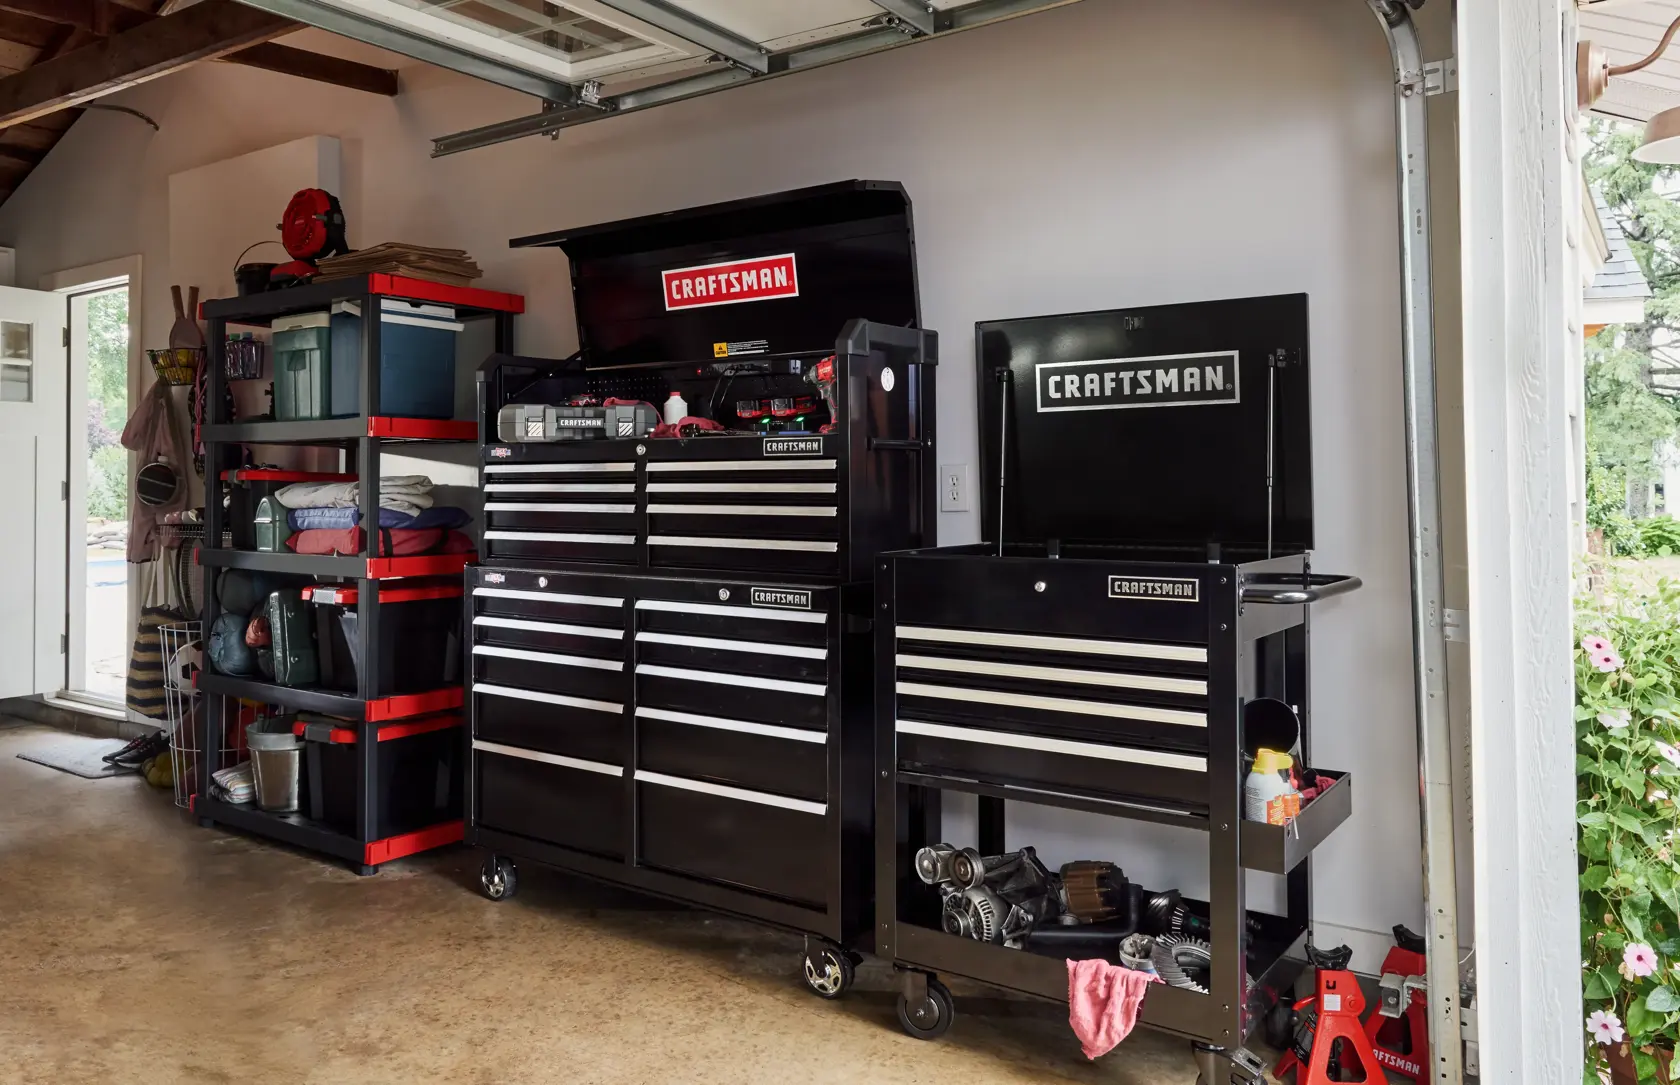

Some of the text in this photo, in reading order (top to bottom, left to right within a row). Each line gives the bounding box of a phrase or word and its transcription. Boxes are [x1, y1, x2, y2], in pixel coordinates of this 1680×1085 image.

[671, 266, 787, 299] CRAFTSMAN
[1048, 365, 1223, 398] CRAFTSMAN
[766, 441, 819, 451] CRAFTSMAN
[754, 591, 807, 605] CRAFTSMAN
[1114, 581, 1192, 596] CRAFTSMAN
[1372, 1048, 1420, 1075] AFTSMAN
